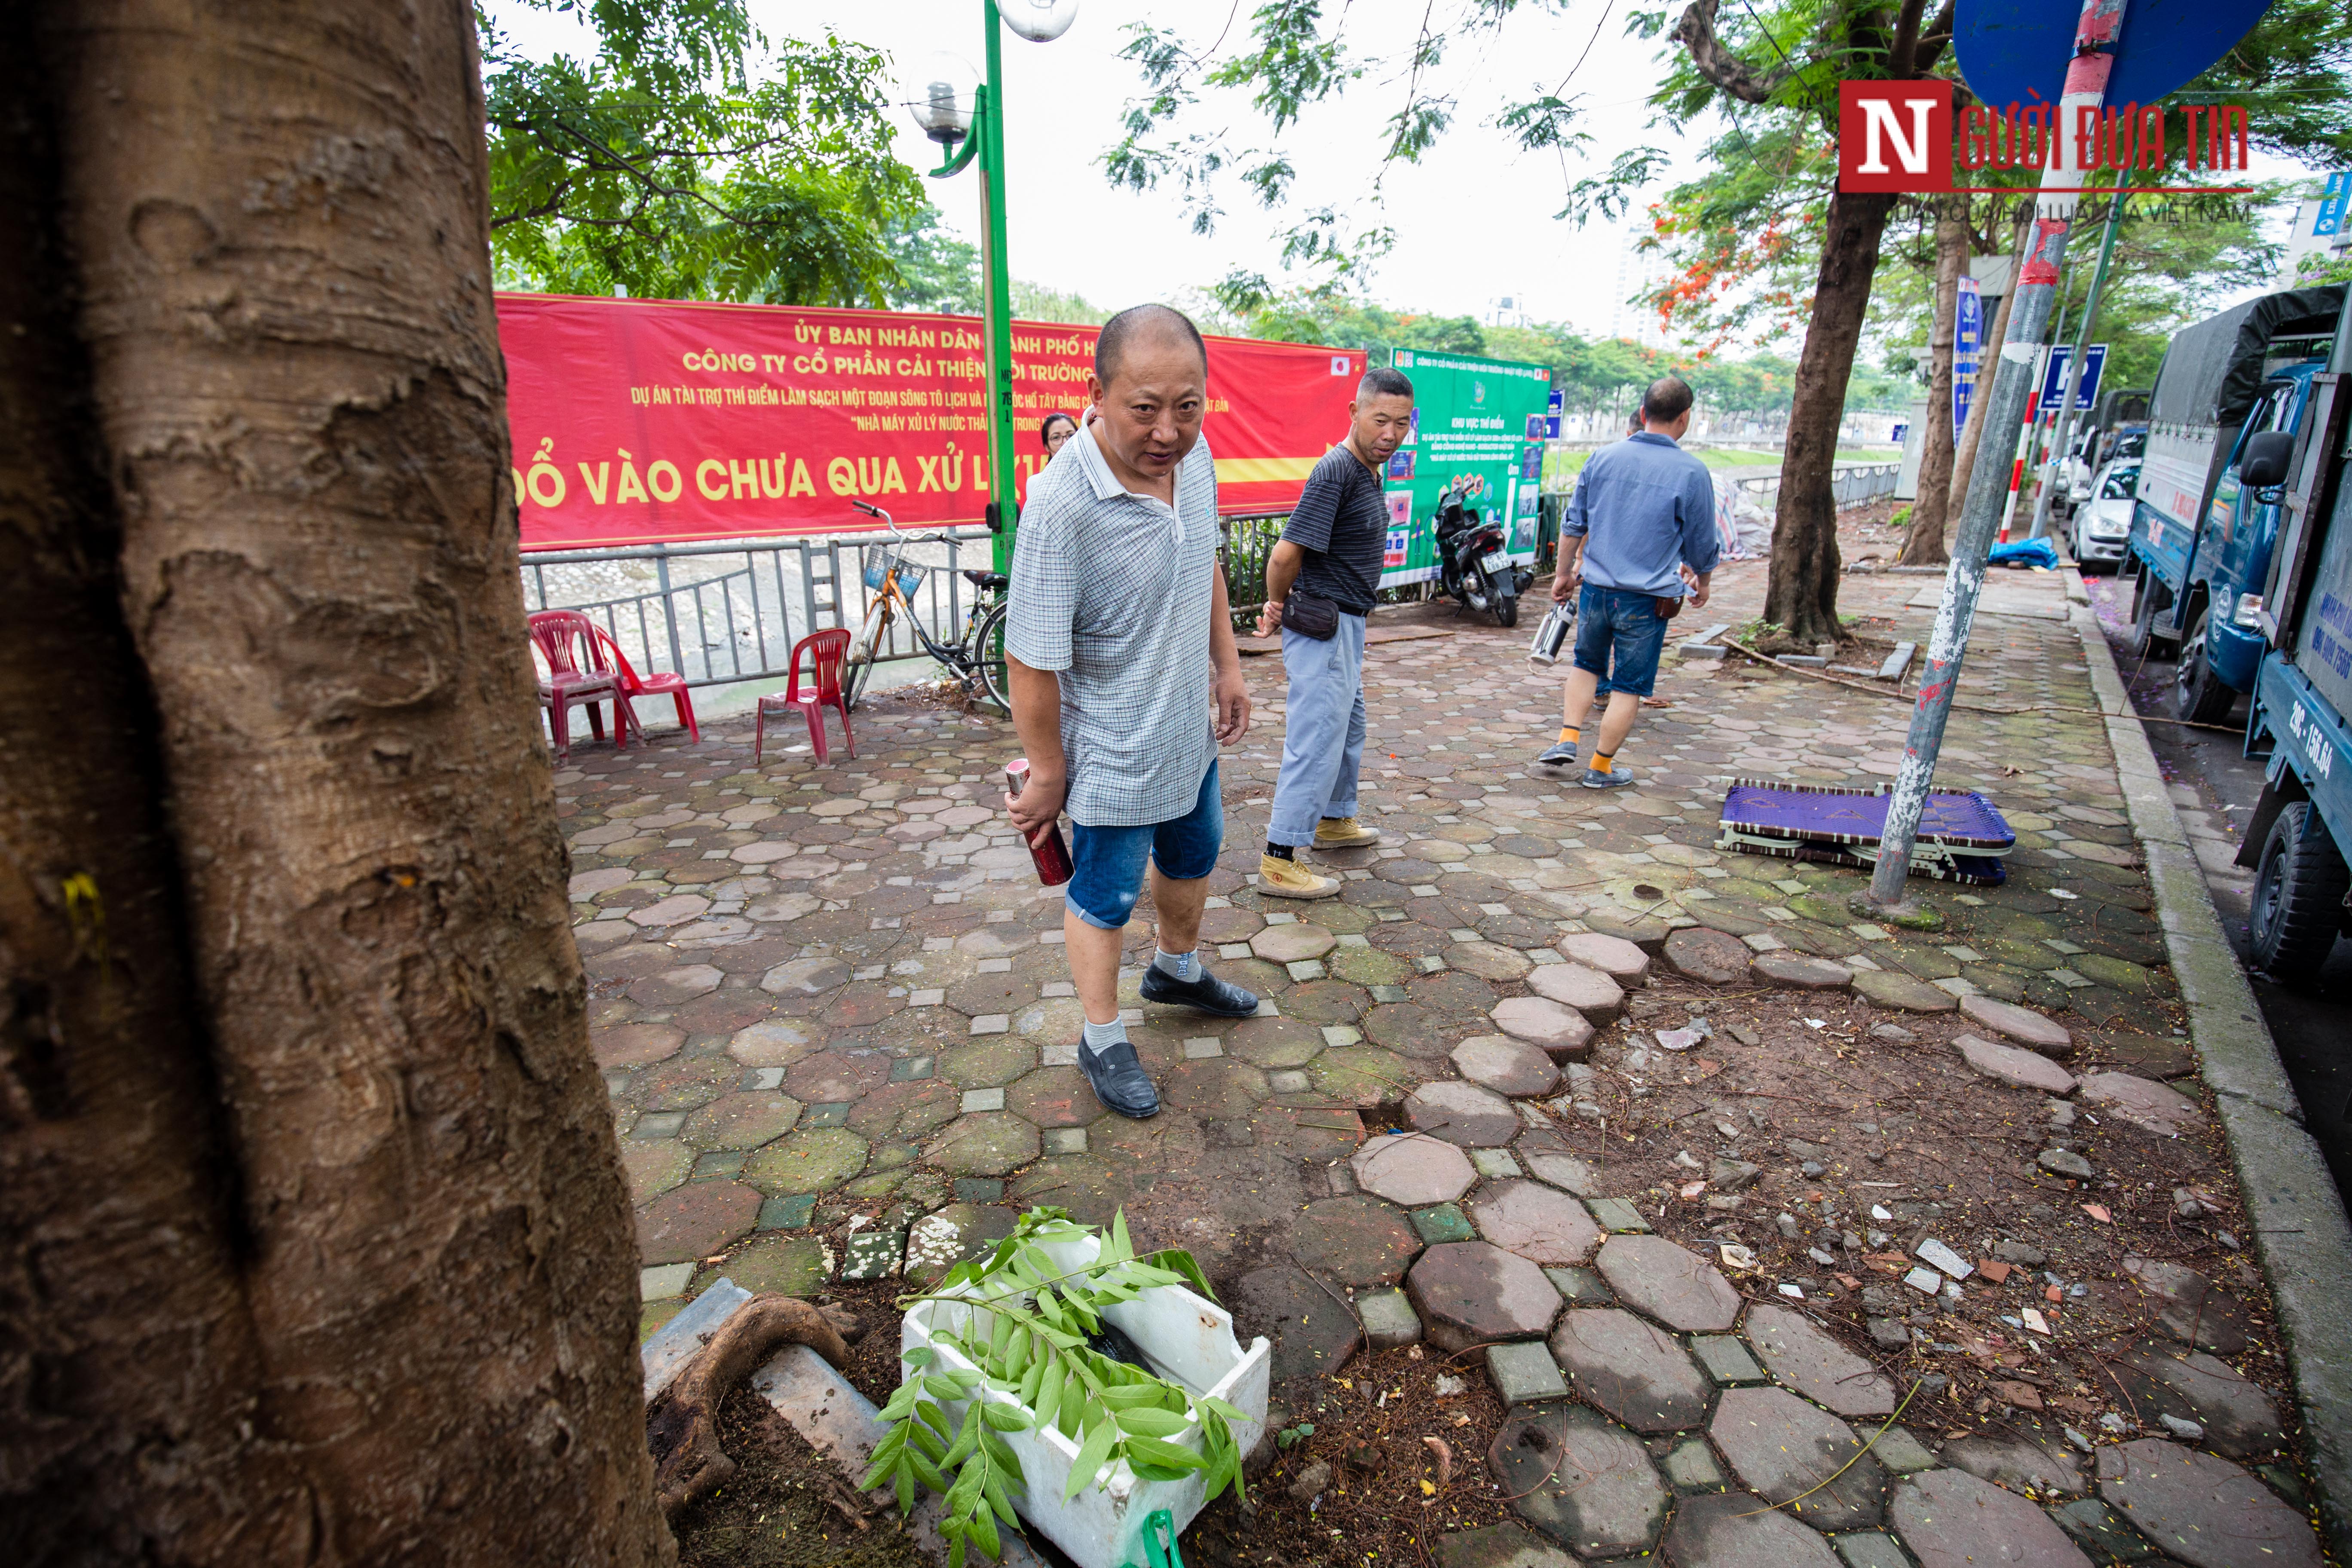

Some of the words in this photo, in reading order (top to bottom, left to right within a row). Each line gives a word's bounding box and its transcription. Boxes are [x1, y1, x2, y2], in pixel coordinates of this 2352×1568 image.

[795, 319, 821, 343] ỦY
[830, 327, 871, 345] BAN
[879, 326, 934, 347] NHÂN
[941, 328, 979, 349] DÂN
[1011, 331, 1041, 354] ÀNH
[1046, 333, 1081, 356] PHỐ
[1084, 340, 1095, 356] H
[683, 348, 755, 371] CÔNG
[762, 355, 785, 372] TY
[794, 347, 827, 374] CỔ
[834, 349, 890, 375] PHẦN
[897, 354, 931, 376] CẢI
[936, 355, 986, 383] THIỆN
[1011, 359, 1026, 380] ÔI
[1029, 361, 1094, 382] TRƯỜNG
[631, 387, 649, 407] DỰ
[654, 385, 671, 404] ÁN
[674, 385, 695, 404] TÀI
[697, 388, 722, 407] TRỢ
[724, 386, 745, 404] THÍ
[748, 383, 778, 404] ĐIỂM
[781, 388, 806, 404] LÀM
[809, 390, 839, 407] SẠCH
[842, 388, 865, 408] MỘT
[869, 391, 897, 408] ĐOẠN
[900, 389, 927, 406] SÔNG
[929, 389, 942, 406] TÔ
[945, 392, 966, 408] LỊCH
[969, 391, 981, 406] VÀ
[1012, 391, 1024, 408] ÓC
[1025, 391, 1037, 408] HỒ
[1038, 392, 1056, 409] TÂY
[1058, 390, 1080, 409] BẰNG
[1215, 396, 1229, 413] BẢN
[882, 414, 904, 430] MÁY
[908, 412, 922, 430] XỬ
[924, 414, 936, 430] LÝ
[939, 414, 965, 430] NƯỚC
[1451, 417, 1465, 429] KHU
[1465, 416, 1479, 431] VỰC
[1480, 416, 1490, 429] THÍ
[578, 448, 682, 504] VÀO
[696, 453, 816, 500] CHƯA
[827, 457, 906, 496] QUA
[916, 442, 963, 492] XỬ
[973, 453, 990, 492] L
[1508, 463, 1519, 475] 0m
